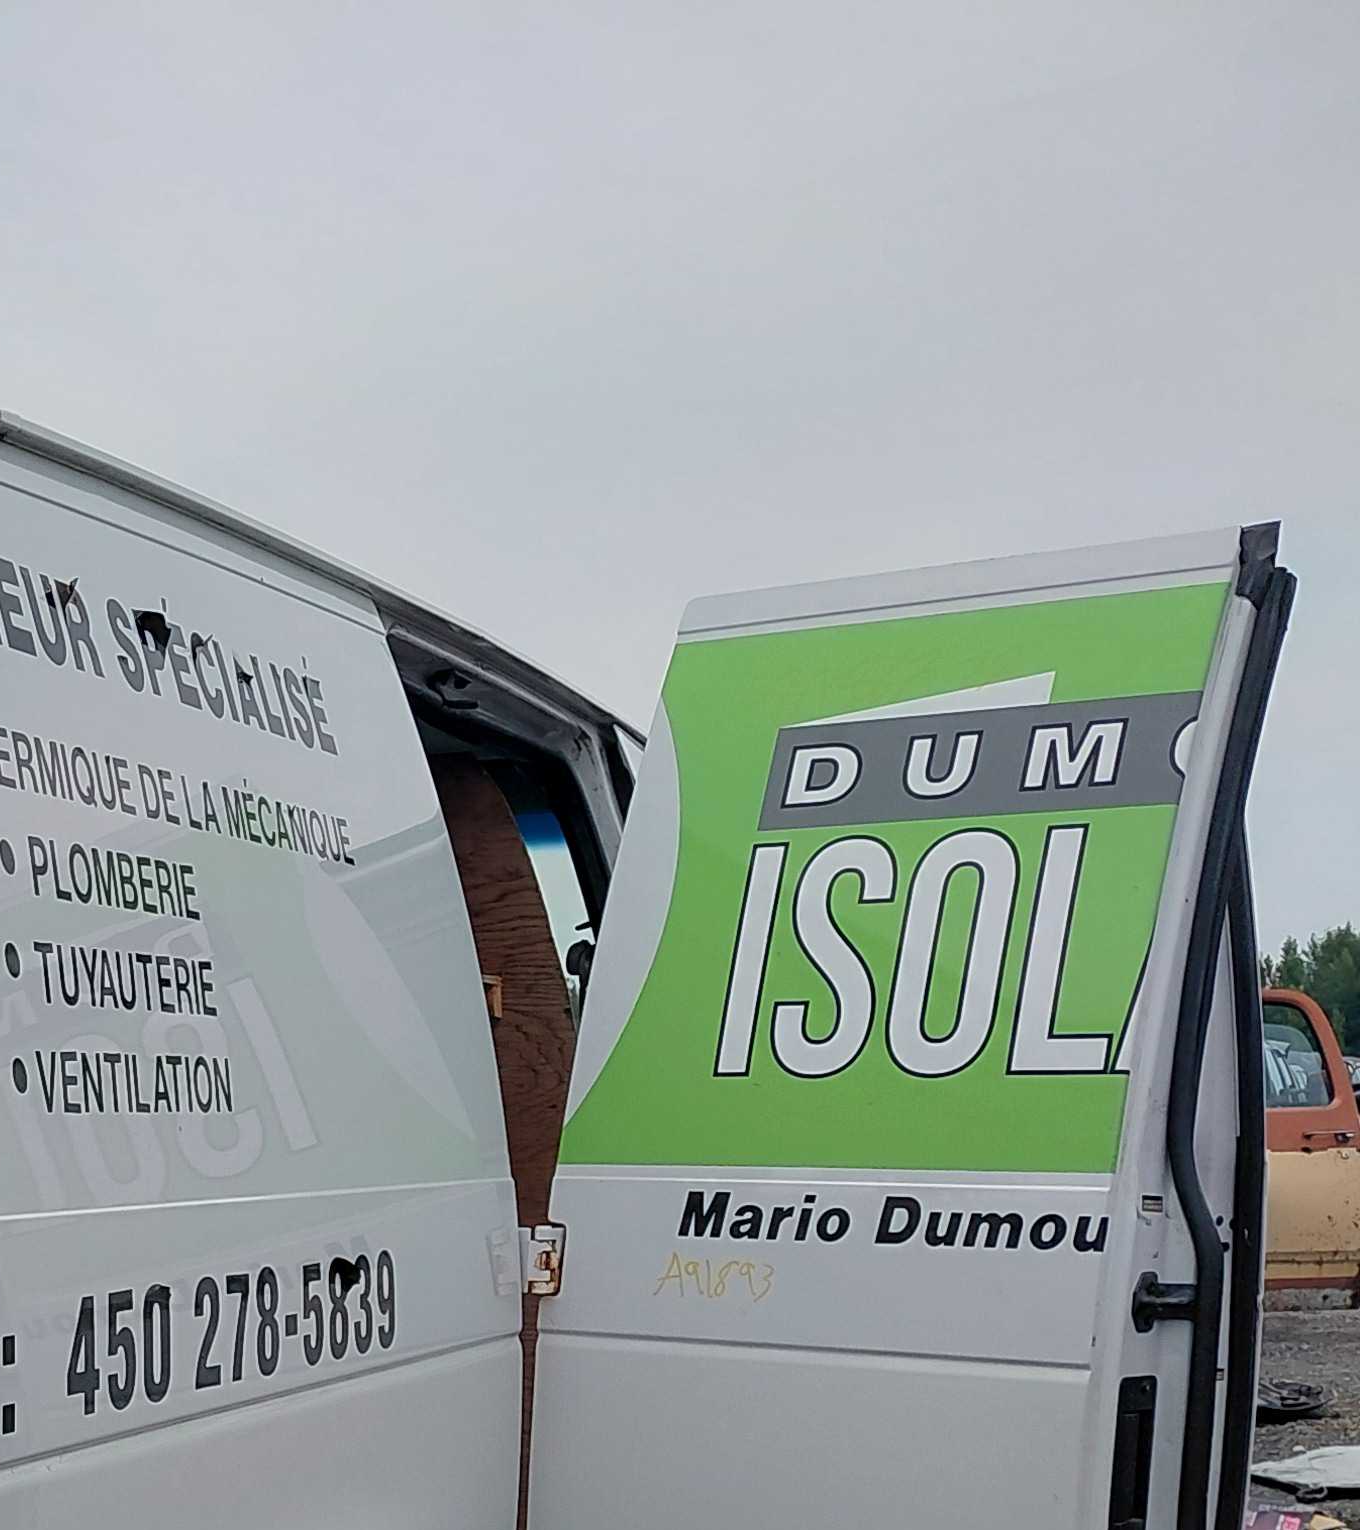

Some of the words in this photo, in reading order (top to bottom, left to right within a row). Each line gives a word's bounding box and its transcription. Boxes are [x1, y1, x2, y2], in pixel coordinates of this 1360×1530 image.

[106, 598, 338, 755] SPÉCIALISÉ
[138, 765, 175, 822] DE
[177, 774, 221, 835] LA
[222, 777, 355, 868] MÉCANIQUE
[29, 835, 200, 921] PLOMBERIE
[32, 940, 218, 1016] TUYAUTERIE
[714, 823, 1130, 1077] ISOL
[35, 1051, 232, 1114] VENTILATION
[677, 1189, 850, 1245] Mario
[875, 1197, 1109, 1253] Dumou
[65, 1285, 171, 1415] 450
[194, 1249, 396, 1390] 278-5839
